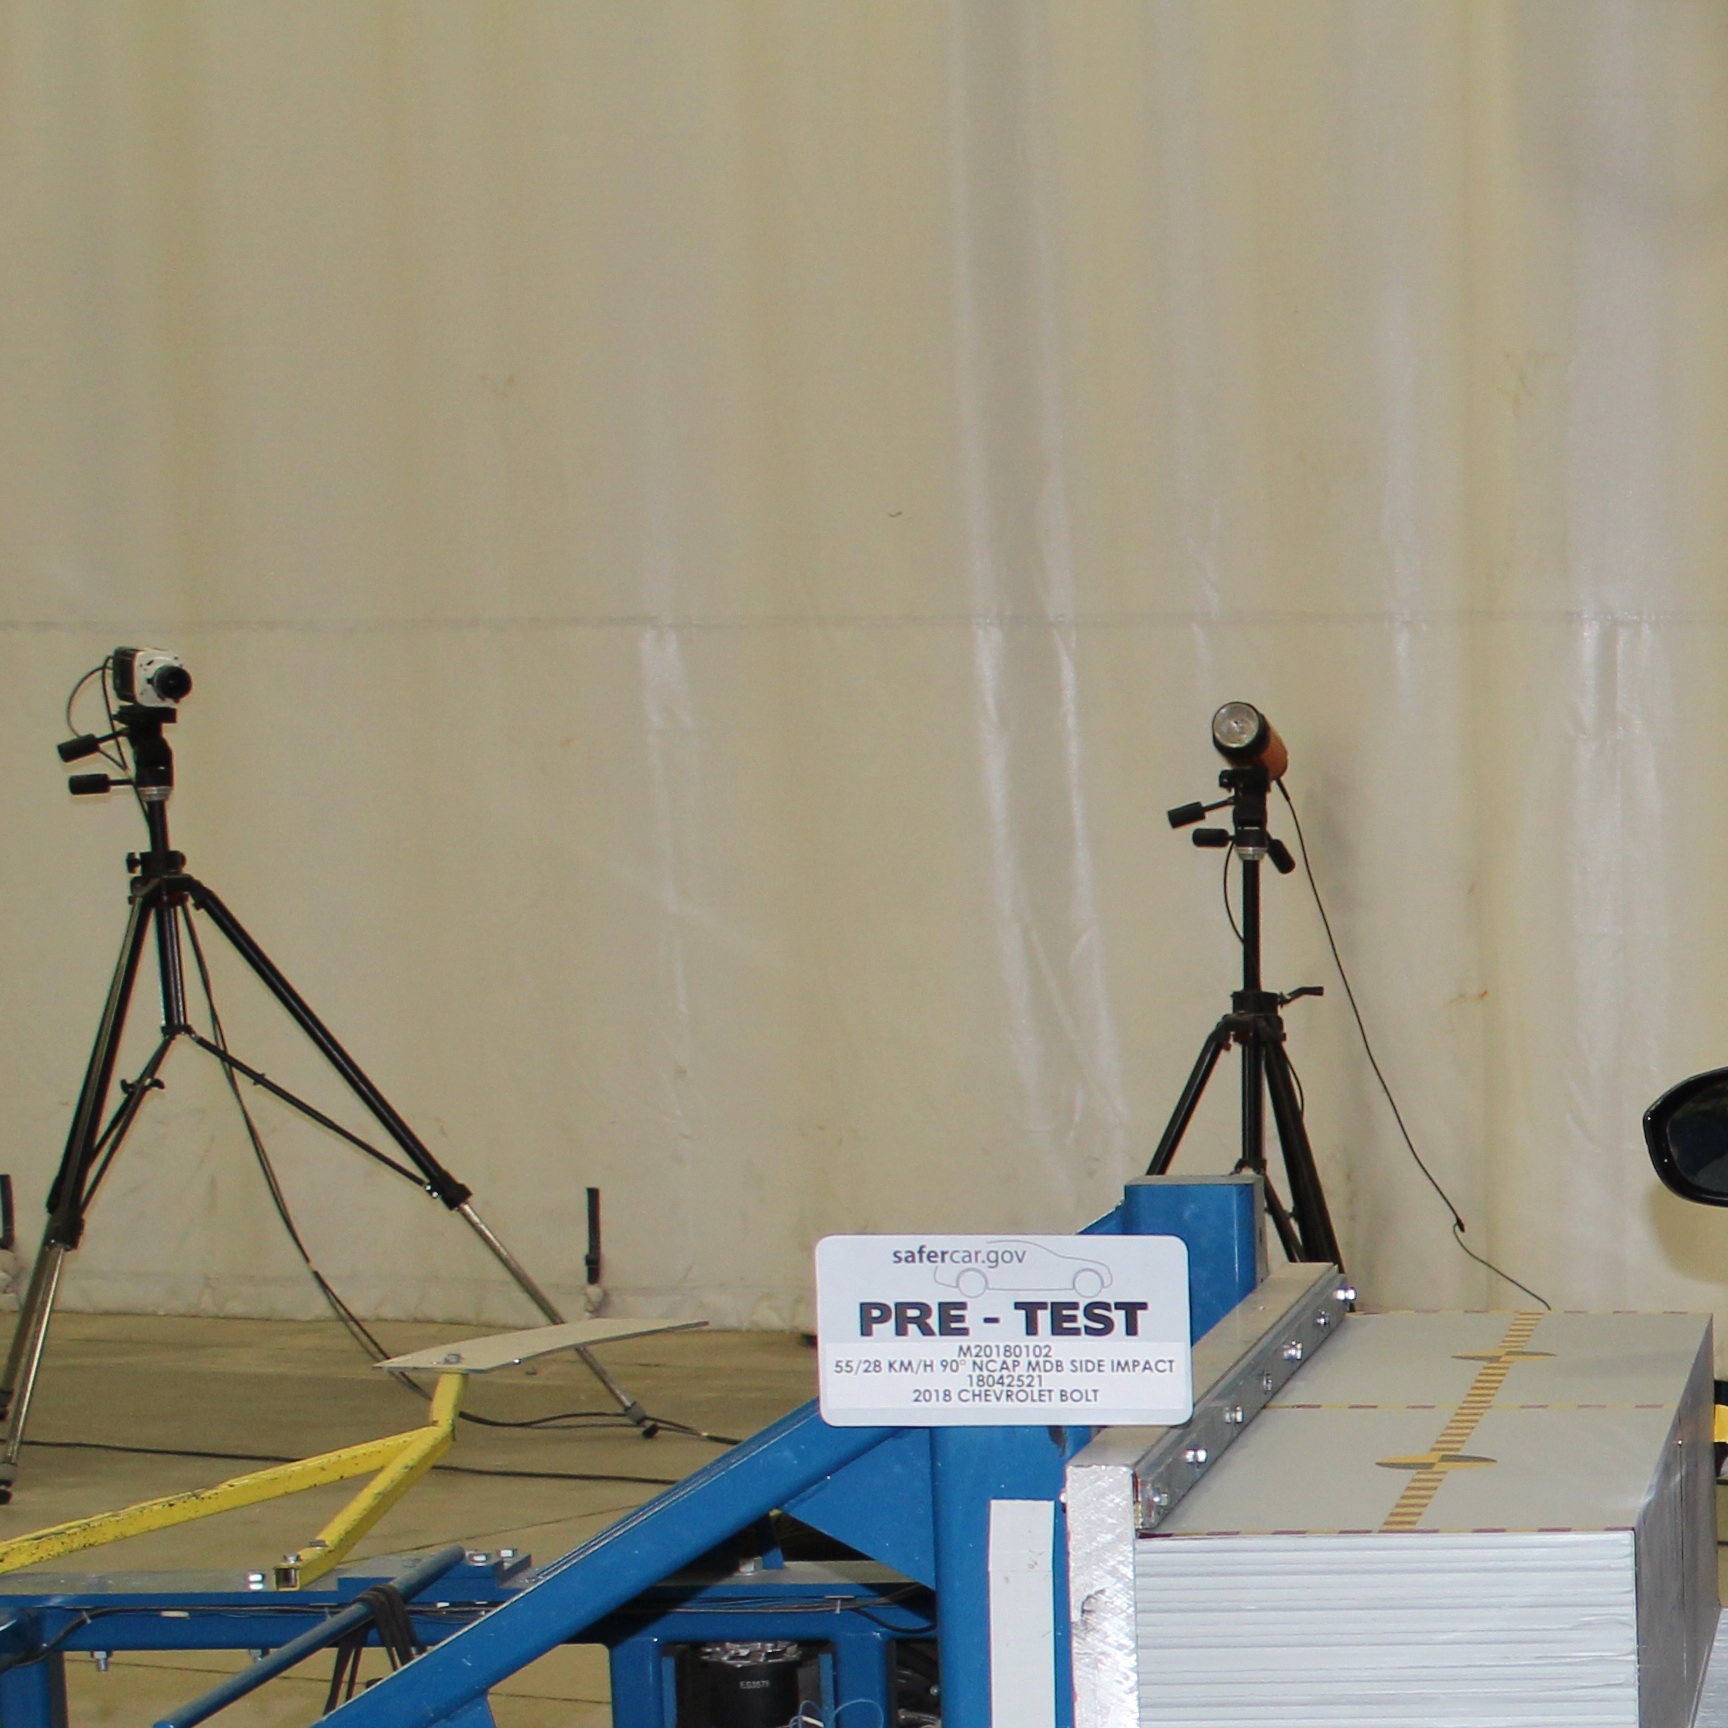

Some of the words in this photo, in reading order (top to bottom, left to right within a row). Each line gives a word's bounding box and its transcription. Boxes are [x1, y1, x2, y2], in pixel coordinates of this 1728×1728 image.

[892, 1245, 1027, 1268] safercar.gov
[859, 1301, 970, 1337] PRE
[1013, 1301, 1149, 1337] TEST
[957, 1344, 1053, 1358] M20180102
[834, 1359, 883, 1375] 55/28
[887, 1359, 934, 1375] KM/H
[939, 1359, 966, 1374] 90°
[971, 1359, 1021, 1373] NCAP
[1026, 1359, 1065, 1373] MDB
[1069, 1359, 1105, 1373] SIDE
[1110, 1359, 1175, 1374] IMPACT
[967, 1373, 1043, 1388] 18042521
[912, 1389, 952, 1403] 2018
[957, 1388, 1055, 1403] CHEVROLET
[1059, 1388, 1100, 1403] BOLT
